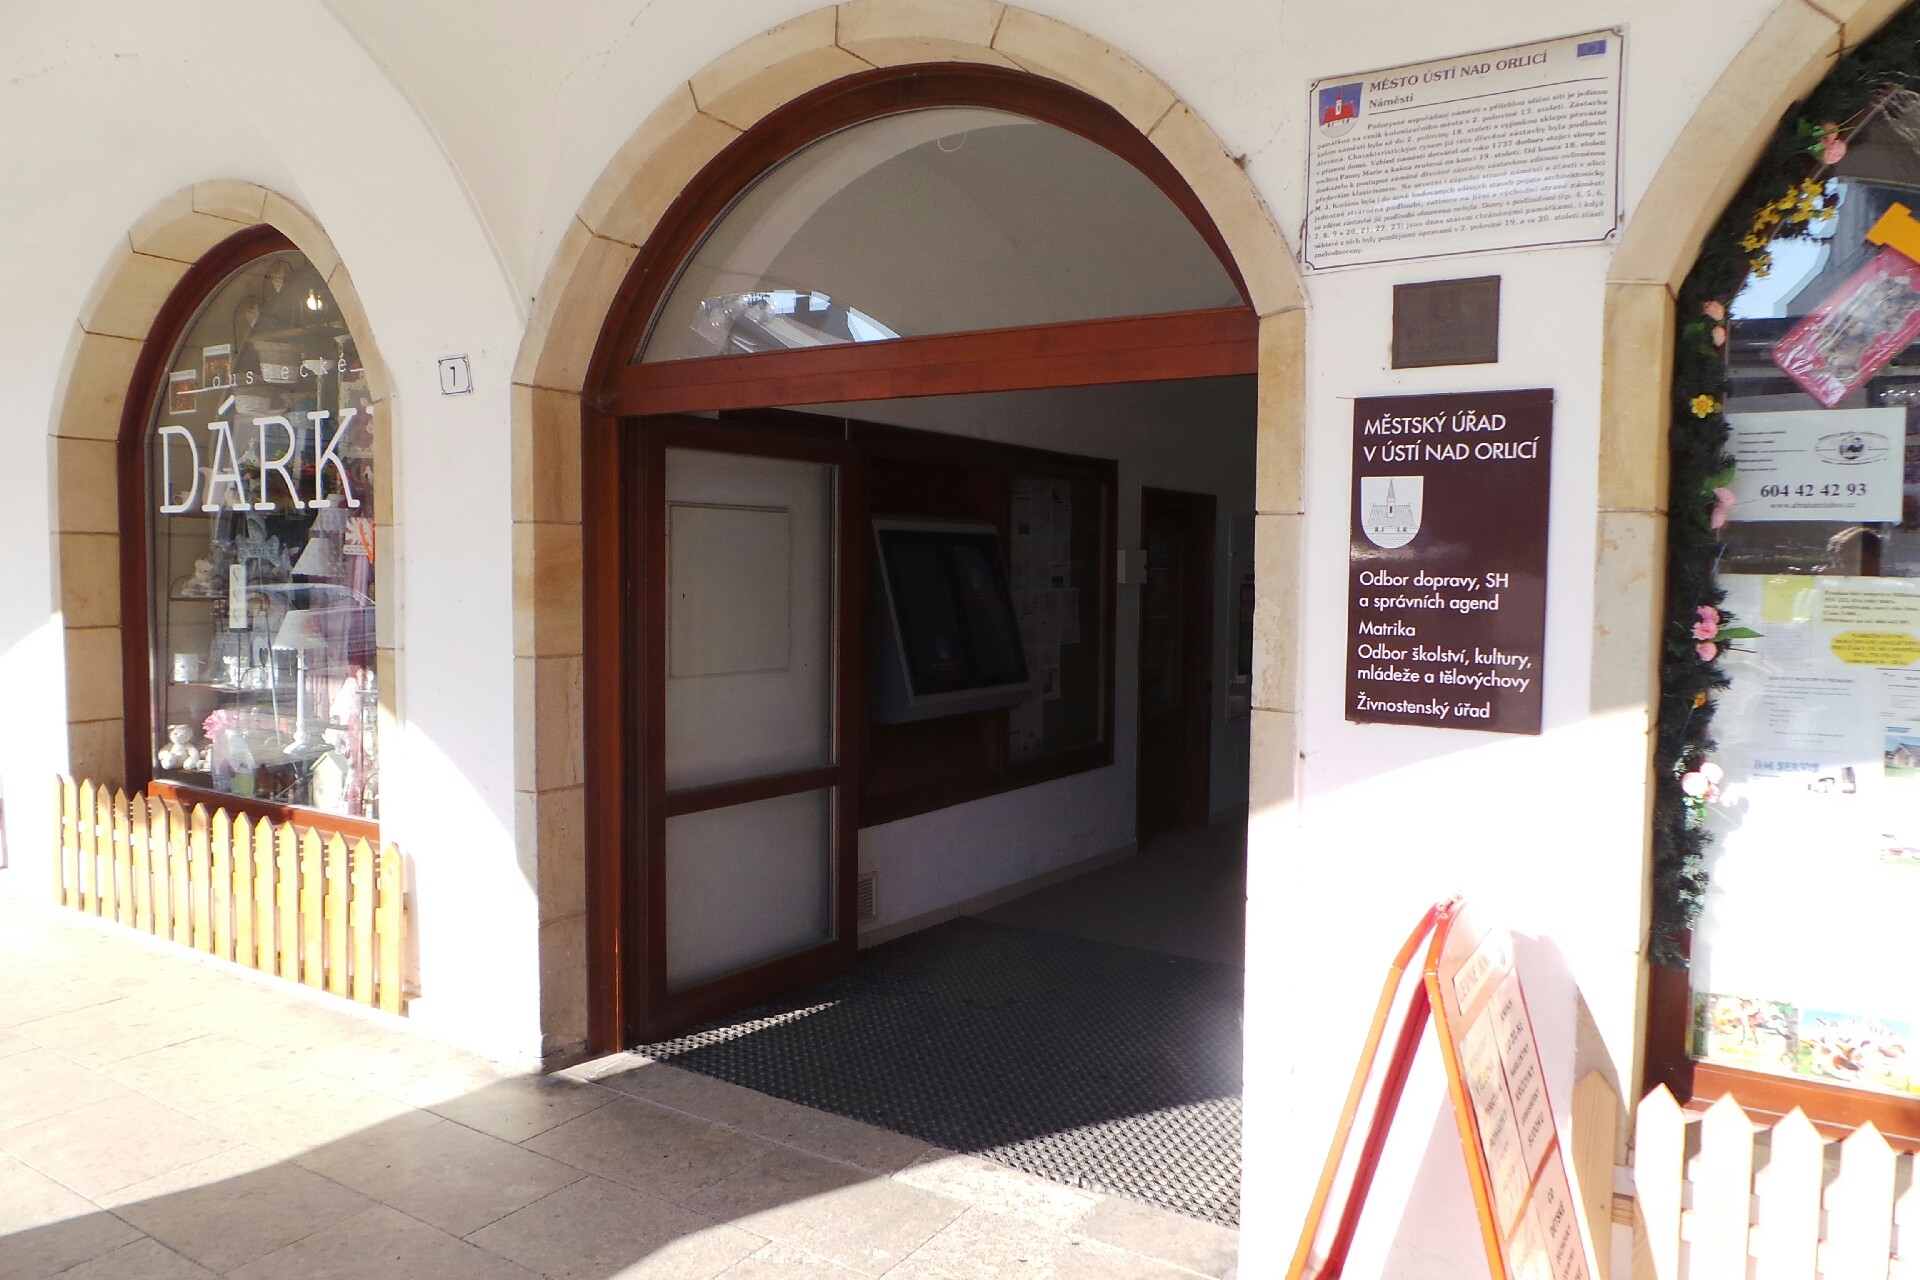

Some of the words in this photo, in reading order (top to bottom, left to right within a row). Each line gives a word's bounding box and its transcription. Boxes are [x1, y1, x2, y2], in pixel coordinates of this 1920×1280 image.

[1370, 74, 1418, 92] MĚSTO
[1423, 66, 1456, 82] ÚSTÍ
[1460, 62, 1492, 78] NAD
[1496, 50, 1548, 72] ORLICÍ
[1369, 94, 1414, 108] Náměstí
[1364, 410, 1446, 435] MĚSTSKÝ
[1452, 410, 1506, 433] ÚŘAD
[158, 394, 374, 514] DÁRK
[1363, 446, 1376, 463] V
[1382, 440, 1421, 462] ÚSTÍ
[1425, 443, 1469, 460] NAD
[1475, 436, 1541, 460] ORLICÍ
[1760, 484, 1790, 498] 604
[1794, 484, 1814, 496] 42
[1820, 484, 1840, 496] 42
[1847, 483, 1867, 496] 93
[1359, 570, 1408, 587] Odbor
[1413, 572, 1480, 592] dopravy,
[1486, 573, 1508, 588] SH
[1359, 596, 1369, 608] a
[1374, 592, 1444, 615] správních
[1449, 595, 1499, 614] agend
[1358, 621, 1415, 637] Matrika
[1358, 644, 1407, 660] Odbor
[1412, 647, 1469, 666] školství,
[1474, 648, 1532, 669] kultury,
[1358, 666, 1419, 683] mládeže
[1424, 673, 1434, 684] a
[1439, 670, 1529, 692] tělovýchovy
[1356, 692, 1449, 719] Živnostenský
[1454, 695, 1490, 718] úřad
